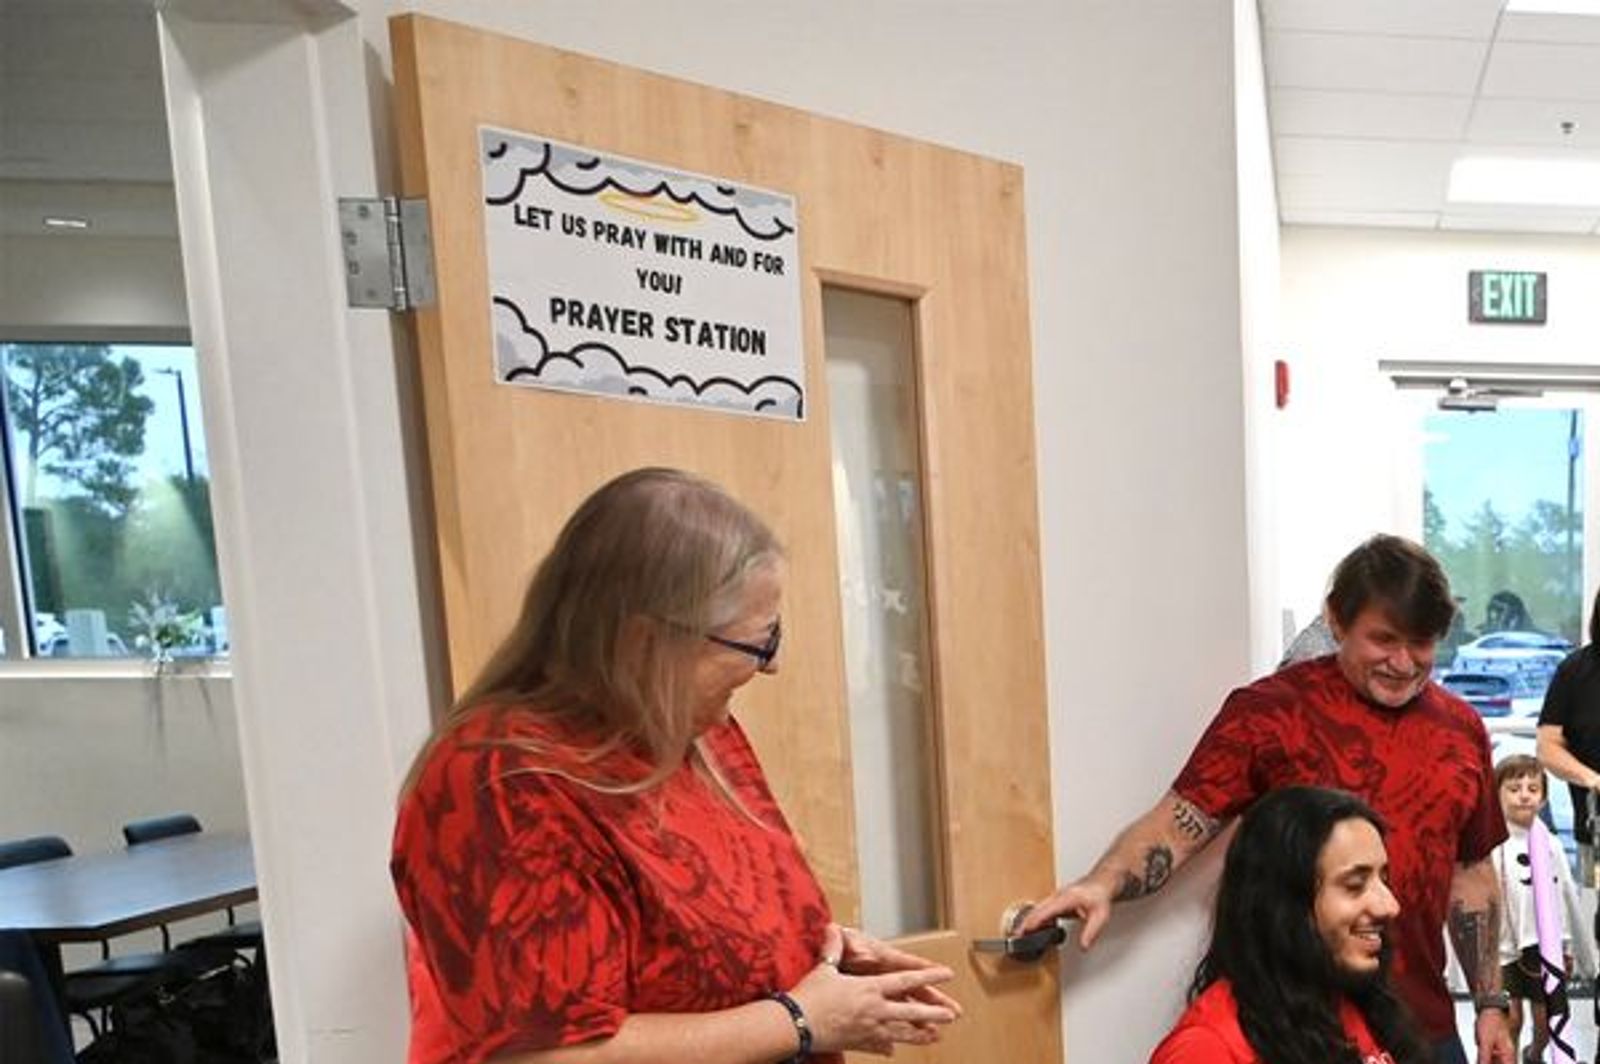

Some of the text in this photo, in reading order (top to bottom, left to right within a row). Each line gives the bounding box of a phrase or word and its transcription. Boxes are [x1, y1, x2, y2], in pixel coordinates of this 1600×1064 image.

[513, 203, 785, 275] LET US PRAY WITH AND FOR
[636, 268, 683, 295] YOU!
[1483, 273, 1537, 318] EXIT
[549, 297, 767, 355] PRAYER STATION
